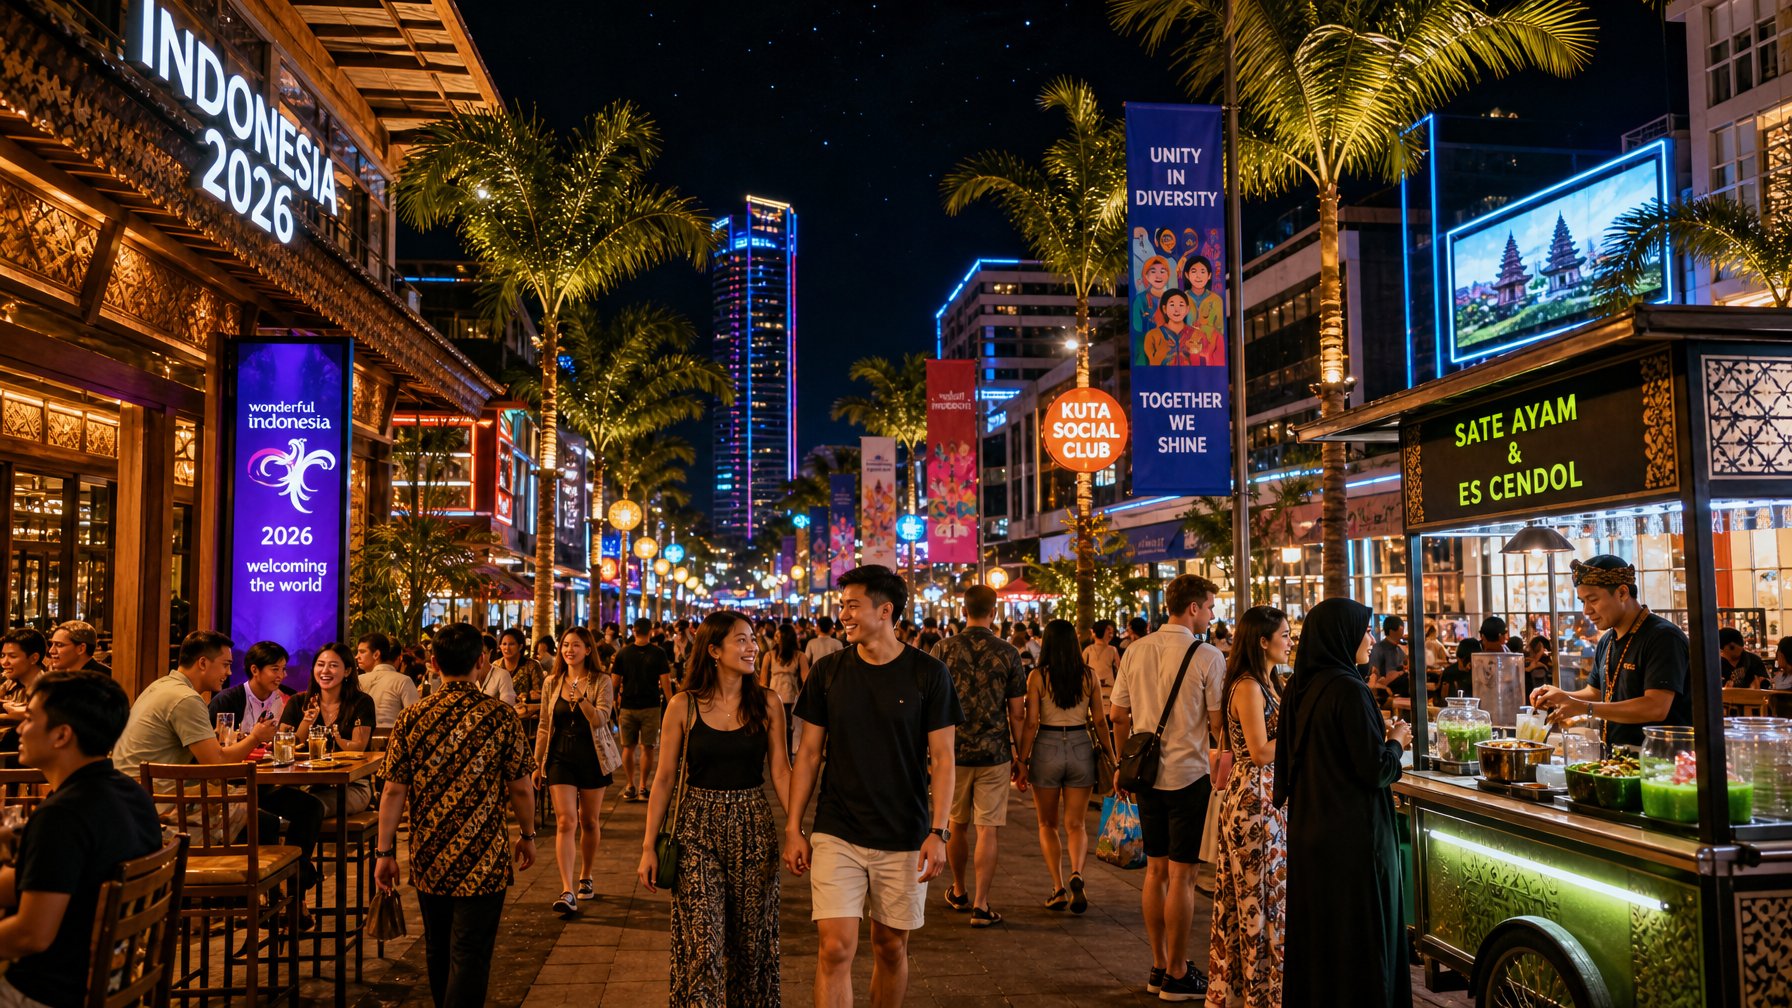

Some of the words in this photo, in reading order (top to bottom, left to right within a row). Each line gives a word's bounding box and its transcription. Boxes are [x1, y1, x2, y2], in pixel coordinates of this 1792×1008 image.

[141, 0, 338, 217] INDONESIA
[1150, 147, 1202, 164] UNITY
[202, 128, 294, 244] 2026
[1167, 169, 1185, 185] IN
[1136, 190, 1218, 207] DIVERSITY
[248, 401, 315, 413] wonderful
[1139, 391, 1223, 409] TOGETHER
[1061, 402, 1111, 419] KUTA
[248, 413, 331, 429] indonesia
[1168, 414, 1195, 431] WE
[1455, 412, 1505, 447] SATE
[1511, 393, 1578, 434] AYAM
[1052, 421, 1121, 439] SOCIAL
[1062, 441, 1111, 459] CLUB
[1158, 436, 1207, 454] SHINE
[1507, 441, 1522, 465] &
[1459, 480, 1482, 506] ES
[1489, 461, 1583, 501] CENDOL
[260, 526, 313, 545] 2026
[246, 558, 328, 575] welcoming
[249, 577, 275, 592] the
[278, 577, 322, 592] world
